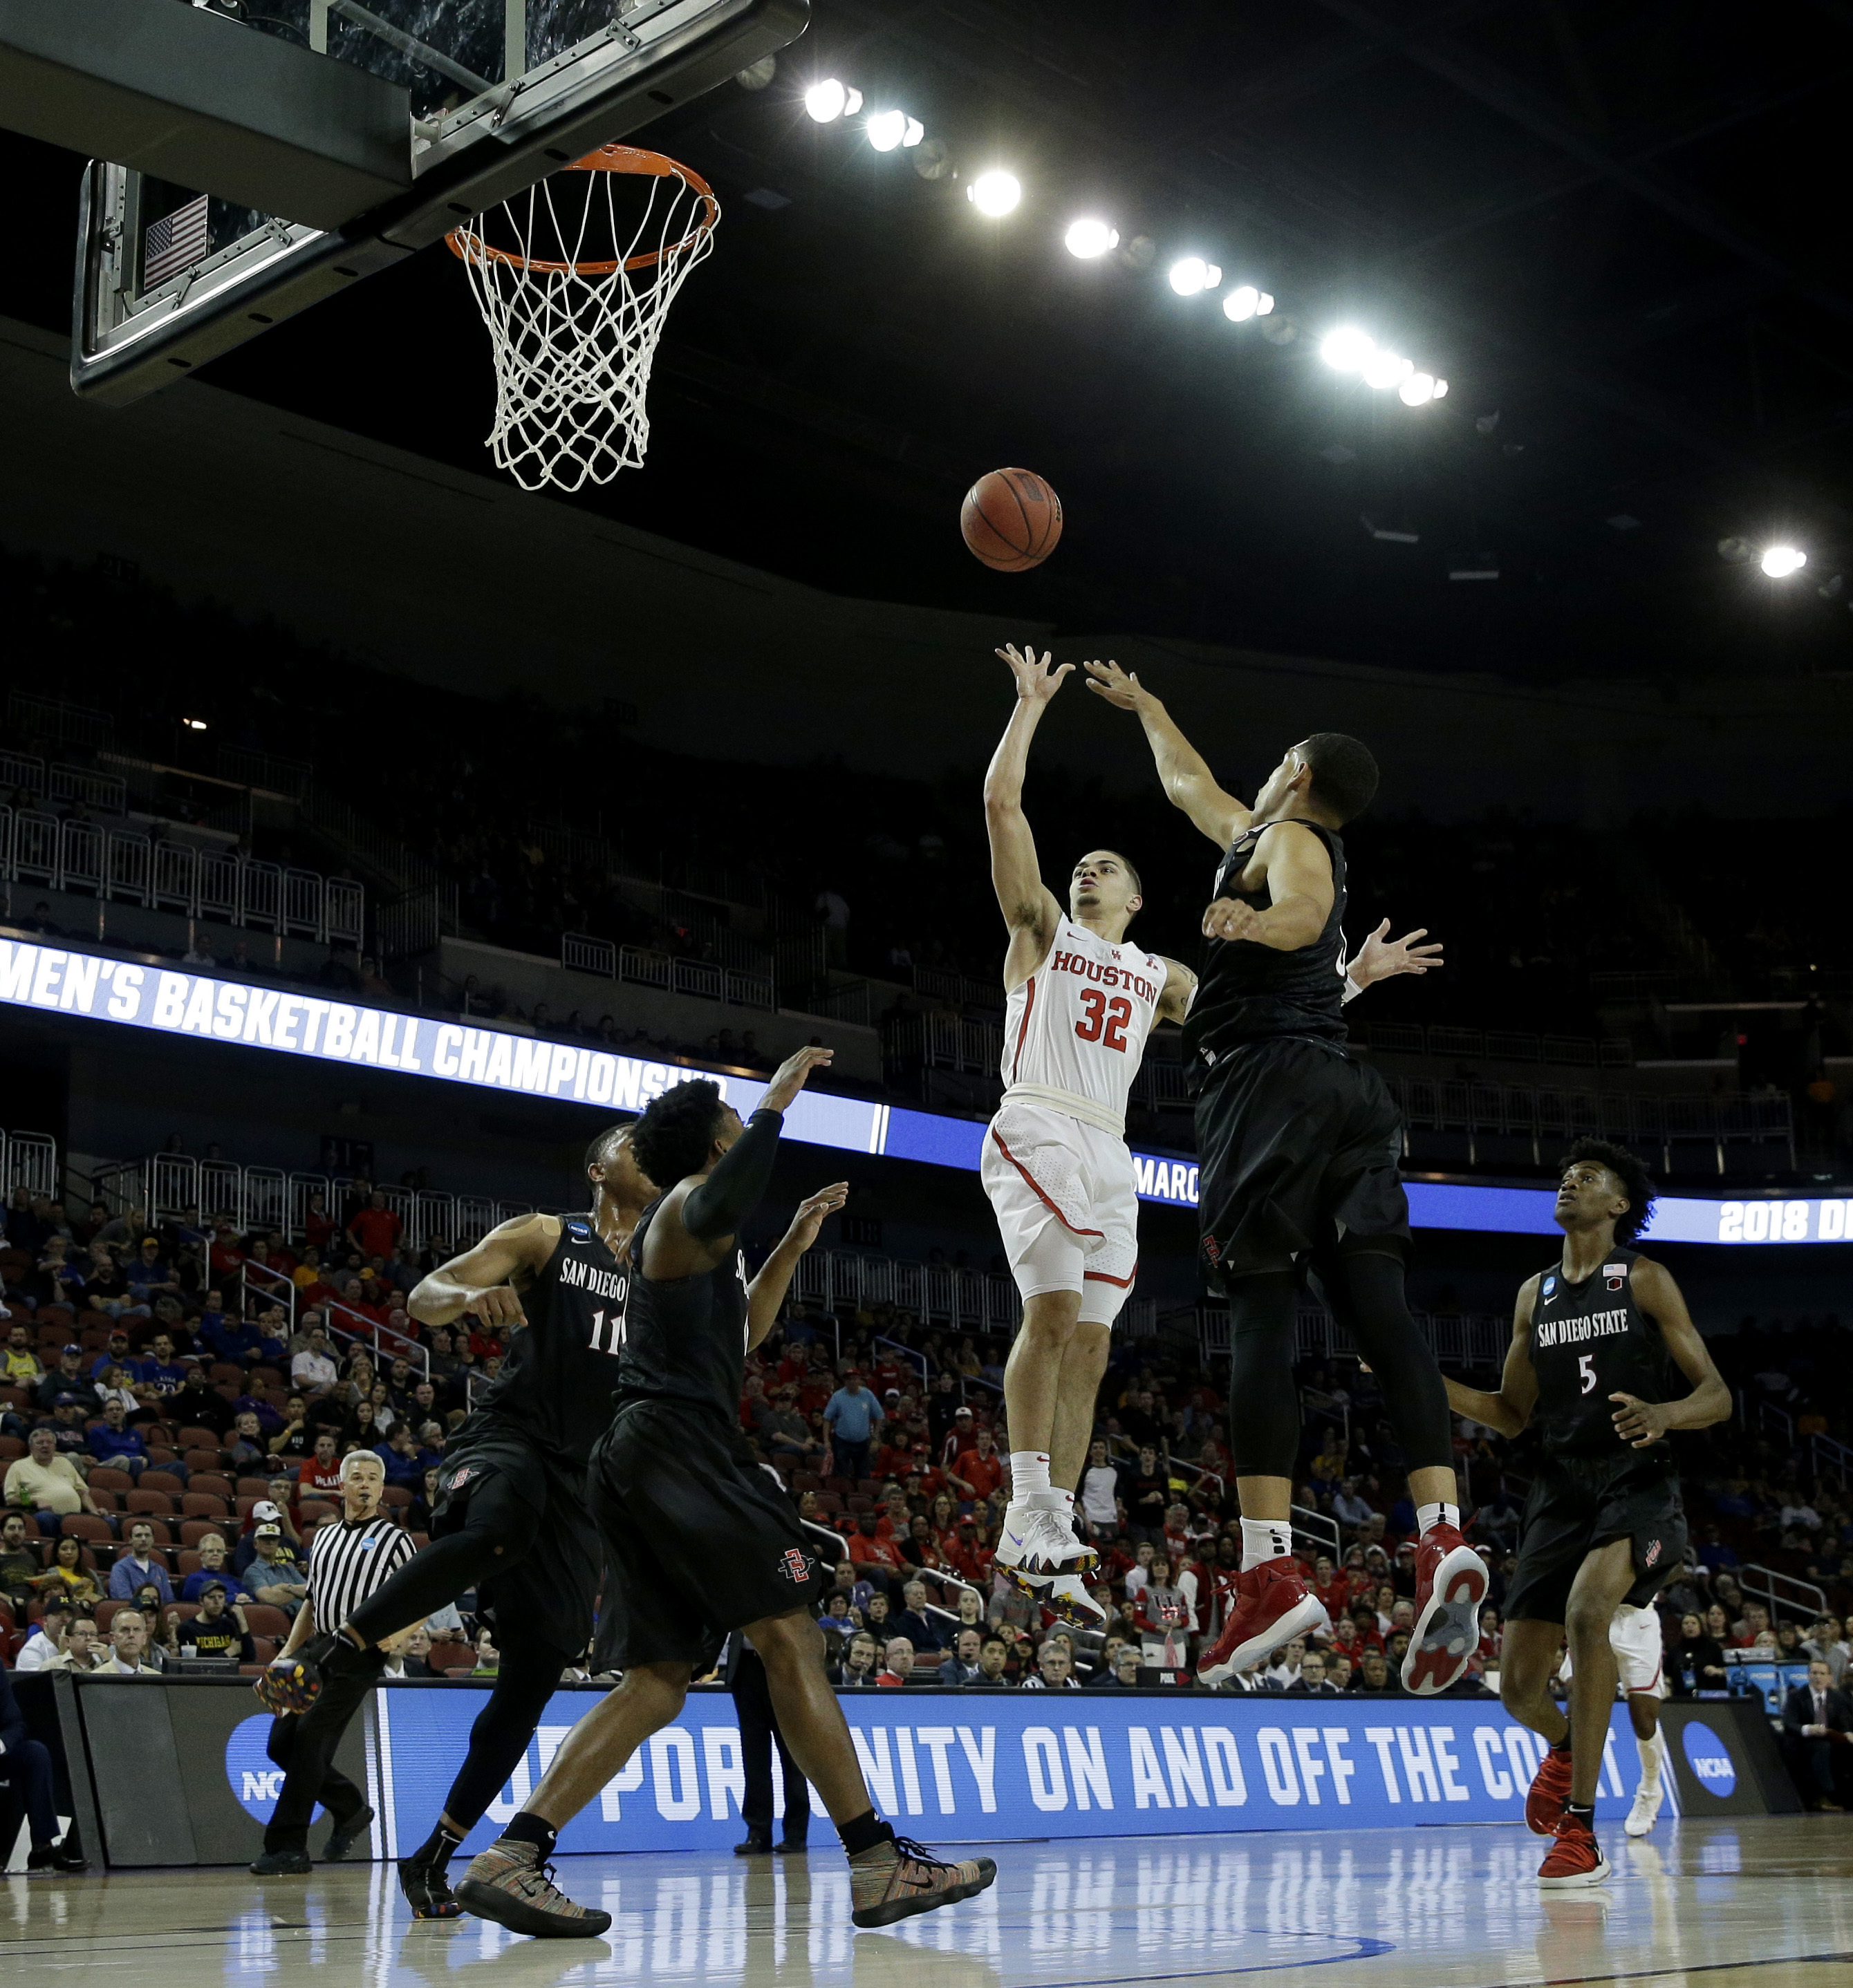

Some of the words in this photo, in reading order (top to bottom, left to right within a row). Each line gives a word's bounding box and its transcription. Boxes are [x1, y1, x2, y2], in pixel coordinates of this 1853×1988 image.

[1051, 950, 1157, 1008] HOUSTON
[0, 941, 145, 1020] MEN'S
[151, 971, 422, 1072] BASKETBALL
[432, 1022, 728, 1111] CHAMPIONS
[1074, 988, 1133, 1053] 32
[1133, 1156, 1200, 1203] MARC
[1718, 1200, 1809, 1241] 2018
[559, 1257, 588, 1288] SAN
[586, 1266, 626, 1302] DIEGO
[588, 1310, 624, 1356] 11
[1538, 1321, 1558, 1347] SAN
[1558, 1315, 1591, 1344] DIEGO
[1592, 1309, 1629, 1338] STATE
[1578, 1354, 1597, 1394] 5
[241, 1770, 287, 1801] NC
[1021, 1727, 1115, 1812] ON
[1128, 1726, 1248, 1809] AND
[1256, 1727, 1355, 1806] OFF
[1364, 1726, 1470, 1803] THE
[1472, 1726, 1625, 1800] COT
[1693, 1758, 1736, 1779] NCAA
